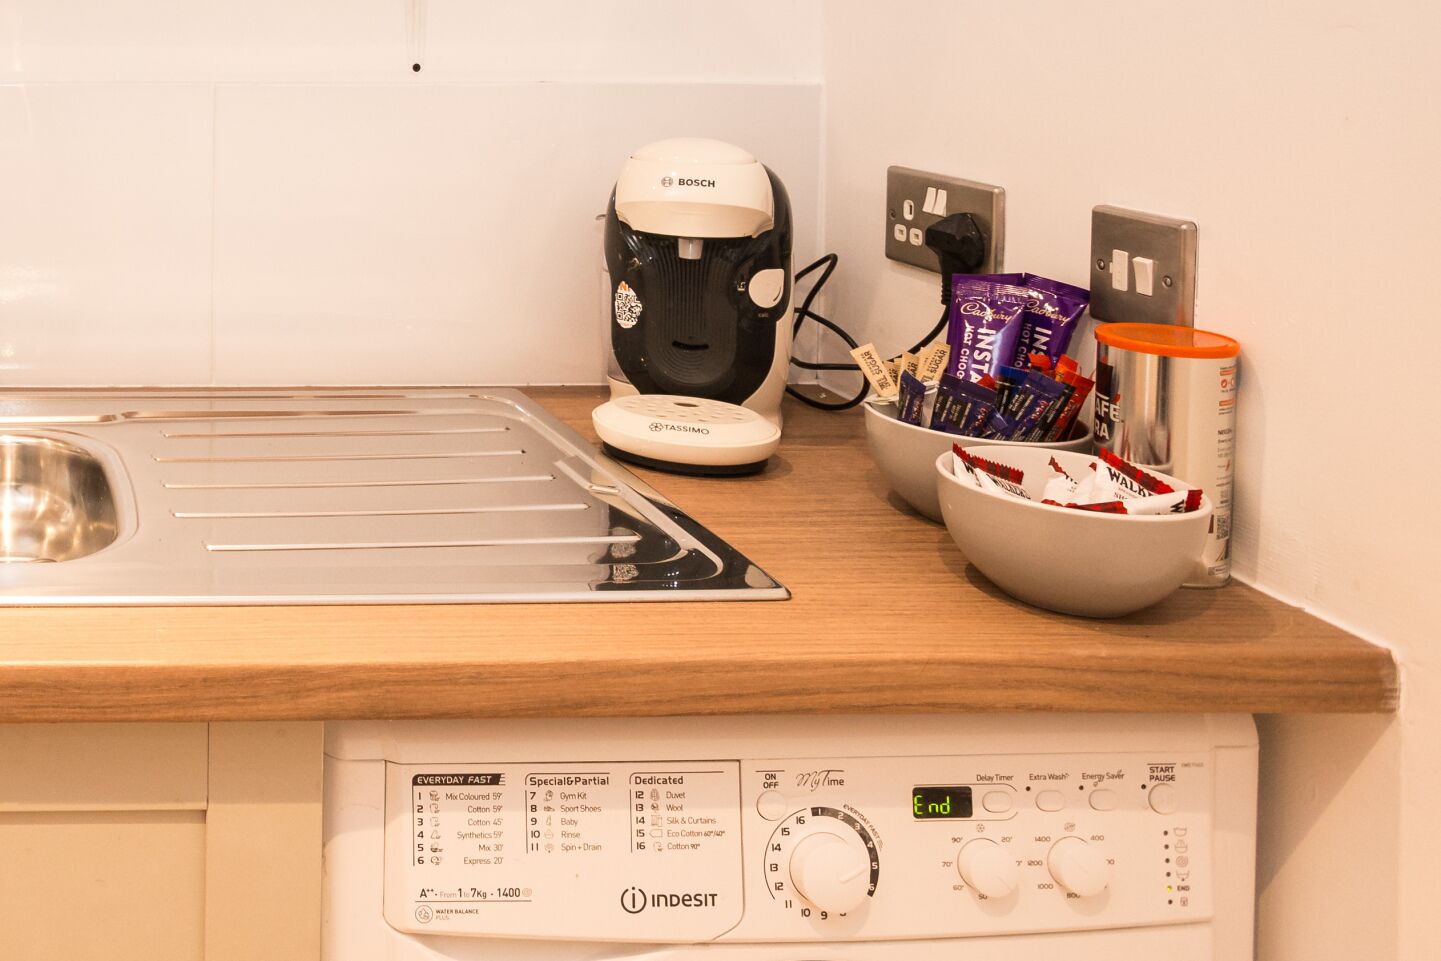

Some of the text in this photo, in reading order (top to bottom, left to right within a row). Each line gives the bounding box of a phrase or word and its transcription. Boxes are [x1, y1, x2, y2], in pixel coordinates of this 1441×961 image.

[678, 178, 716, 188] BOSCH
[1014, 323, 1032, 368] HOT CHO
[970, 328, 997, 383] INSTA
[863, 351, 882, 375] SUGAR
[930, 349, 948, 373] SUGAR
[956, 348, 970, 379] CHOC
[664, 424, 710, 435] TASSIMO
[1106, 466, 1154, 497] WALK
[417, 776, 492, 784] EVERYDAY FAST
[529, 776, 610, 788] Special&Partial
[634, 776, 684, 785] Dedicated
[976, 774, 994, 782] Delay
[1082, 773, 1105, 782] Energy
[763, 781, 779, 789] OFF
[458, 792, 490, 800] Coloured
[530, 792, 587, 801] 7 Gym Kit
[635, 790, 686, 799] 12 Duvet
[417, 805, 424, 813] 2
[467, 805, 491, 813] Cotton
[560, 805, 579, 813] Sport
[913, 794, 951, 815] End
[636, 816, 645, 824] 14
[796, 816, 805, 825] 16
[837, 812, 844, 820] 2
[417, 817, 424, 826] 3
[467, 818, 491, 826] Cotton
[531, 817, 578, 827] 9 Baby
[417, 831, 424, 839] 4
[456, 831, 492, 840] Synthetics
[531, 830, 581, 838] 10 Rinse
[636, 829, 645, 837] 15
[681, 829, 703, 837] Cotton
[781, 827, 790, 836] 15
[417, 843, 424, 851] 5
[531, 843, 539, 851] 11
[561, 843, 577, 852] Spin
[583, 843, 602, 851] Drain
[636, 842, 646, 850] 16
[667, 842, 689, 850] Cotton
[771, 843, 781, 852] 14
[463, 857, 491, 866] Express
[871, 862, 878, 870] 5
[769, 863, 778, 872] 13
[774, 882, 784, 891] 12
[458, 888, 463, 897] 1
[497, 888, 521, 897] 1400
[785, 900, 792, 908] 11
[801, 908, 811, 917] 10
[820, 911, 828, 920] 9
